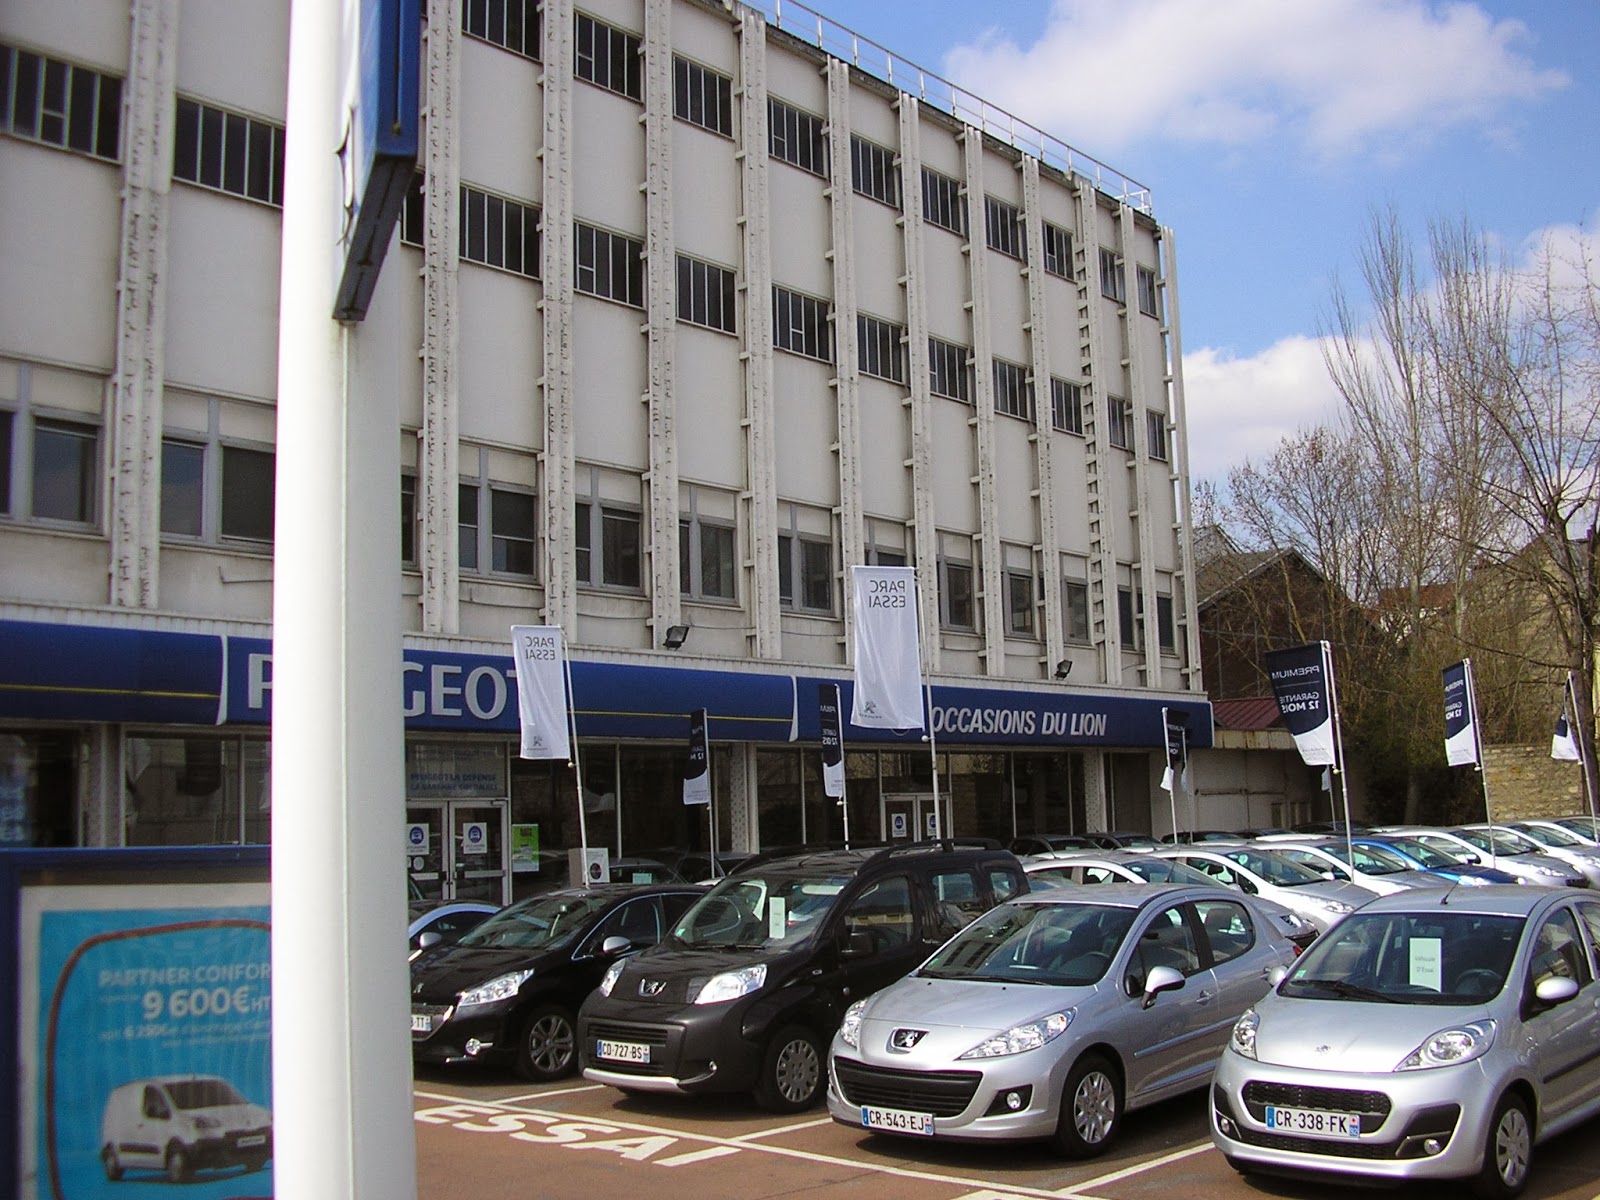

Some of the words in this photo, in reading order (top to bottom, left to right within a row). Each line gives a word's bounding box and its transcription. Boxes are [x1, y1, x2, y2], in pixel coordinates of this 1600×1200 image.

[247, 652, 519, 720] PGEO
[931, 706, 1036, 735] OCCASIONS
[1041, 711, 1067, 736] DU
[1070, 713, 1107, 736] LION
[98, 967, 190, 988] PARTNER
[194, 963, 272, 983] CONFOR
[602, 1042, 643, 1059] CD-727-BS
[869, 1110, 924, 1131] CR-543-EJ
[1275, 1110, 1347, 1133] CR-338-FK
[414, 1103, 742, 1167] ESSAI
